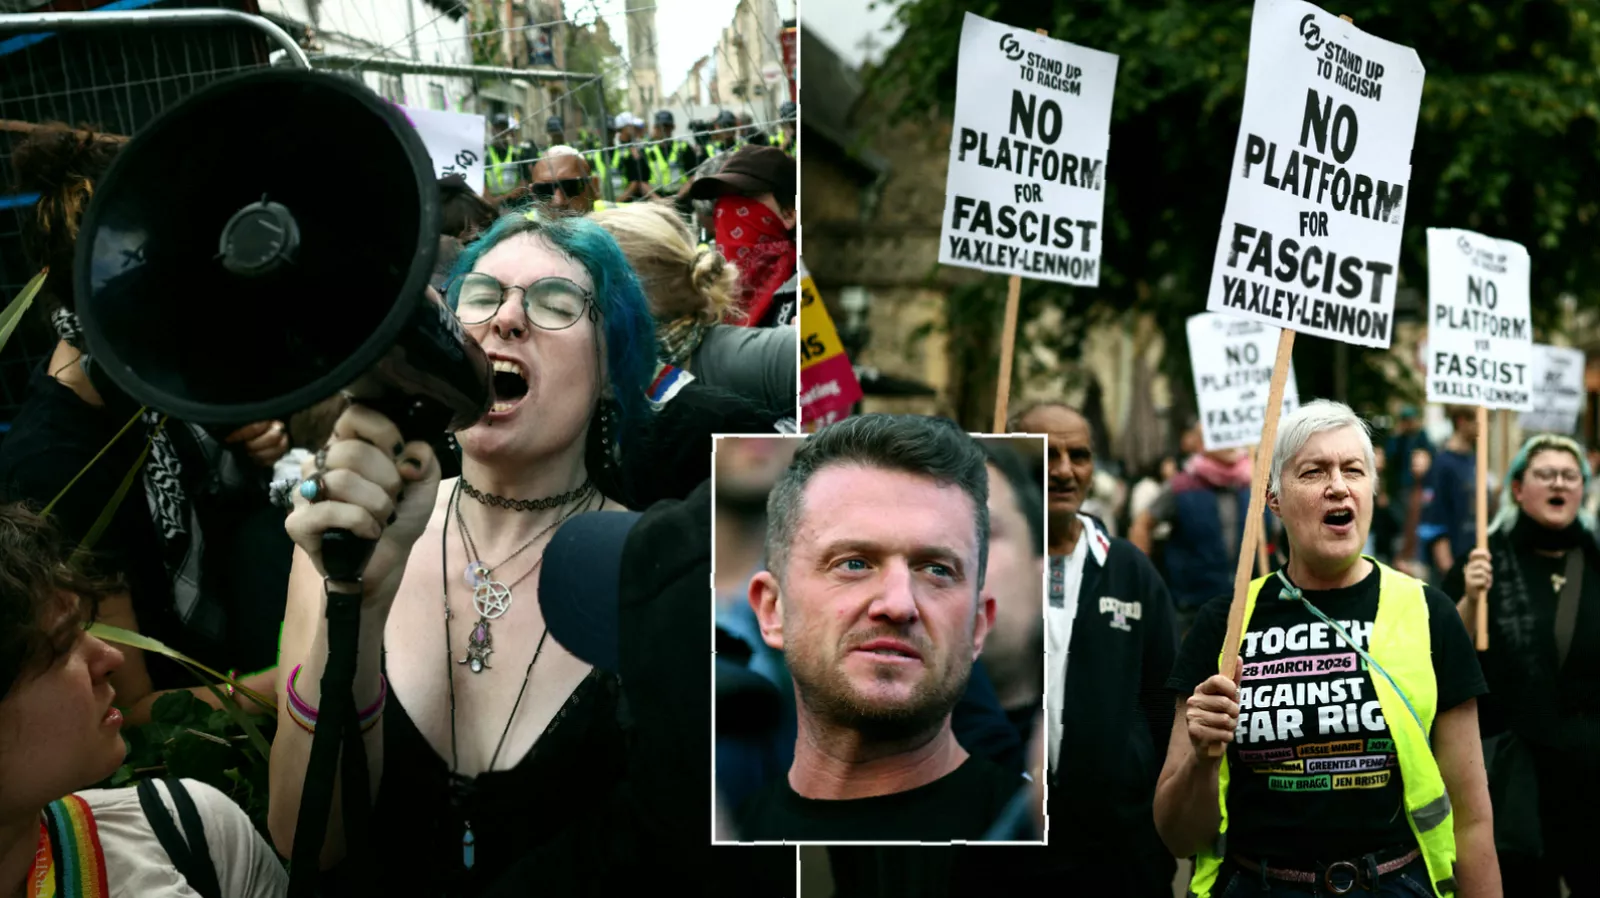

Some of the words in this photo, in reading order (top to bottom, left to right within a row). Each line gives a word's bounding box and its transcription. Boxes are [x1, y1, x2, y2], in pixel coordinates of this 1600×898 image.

[1027, 52, 1063, 76] STAND
[1065, 65, 1082, 80] UP
[1316, 57, 1332, 80] TO
[1334, 66, 1382, 101] RACISM
[1324, 41, 1362, 73] STAND
[1364, 60, 1384, 81] UP
[1020, 65, 1034, 82] TO
[1037, 70, 1082, 96] RACISM
[1009, 89, 1063, 145] NO
[1299, 87, 1358, 164] NO
[958, 127, 1102, 191] PLATFORM
[1014, 183, 1043, 204] FOR
[1242, 133, 1404, 225] PLATFORM
[952, 195, 1097, 252] FASCIST
[1299, 211, 1329, 237] FOR
[949, 235, 1096, 281] YAXLEY-LENNON
[1227, 222, 1393, 304] FASCIST
[1222, 275, 1389, 340] YAXLEY-LENNON
[1467, 274, 1498, 310] NO
[1436, 304, 1526, 340] PLATFORM
[1225, 342, 1259, 366] NO
[1435, 352, 1527, 385] FASCIST
[1243, 665, 1259, 677] 28
[1262, 660, 1313, 675] MARCH
[1316, 656, 1351, 670] 2026
[1239, 677, 1365, 710] AGAINST
[1235, 708, 1304, 744] FAR
[1296, 777, 1328, 789] BRAGG
[1309, 759, 1357, 771] GREENTEA
[1335, 777, 1352, 787] JEN
